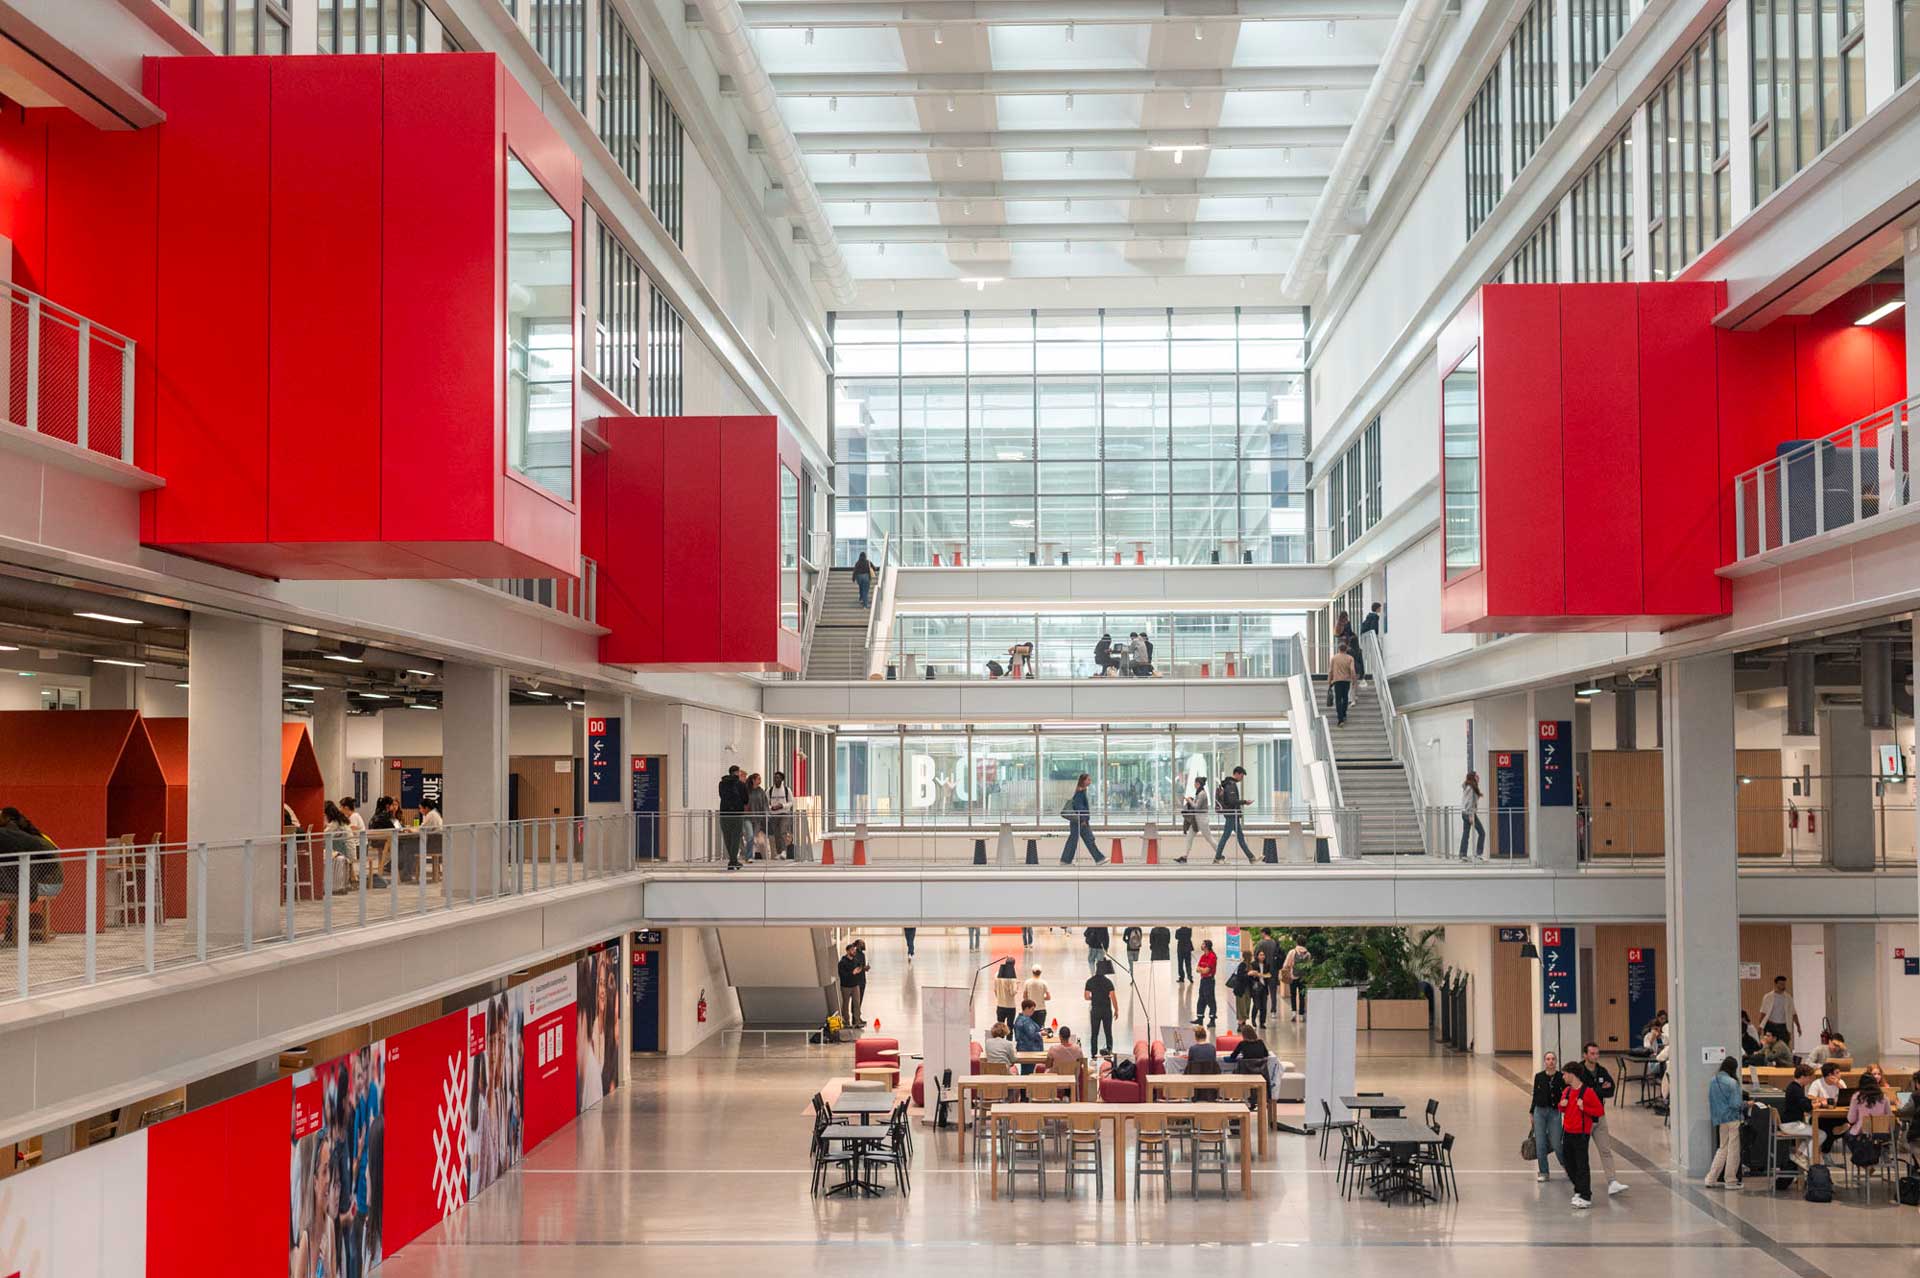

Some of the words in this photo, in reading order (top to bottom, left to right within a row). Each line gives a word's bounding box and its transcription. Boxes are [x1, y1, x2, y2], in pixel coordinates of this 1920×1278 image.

[422, 777, 440, 804] QUE
[911, 754, 936, 807] B
[1544, 931, 1558, 943] C-1
